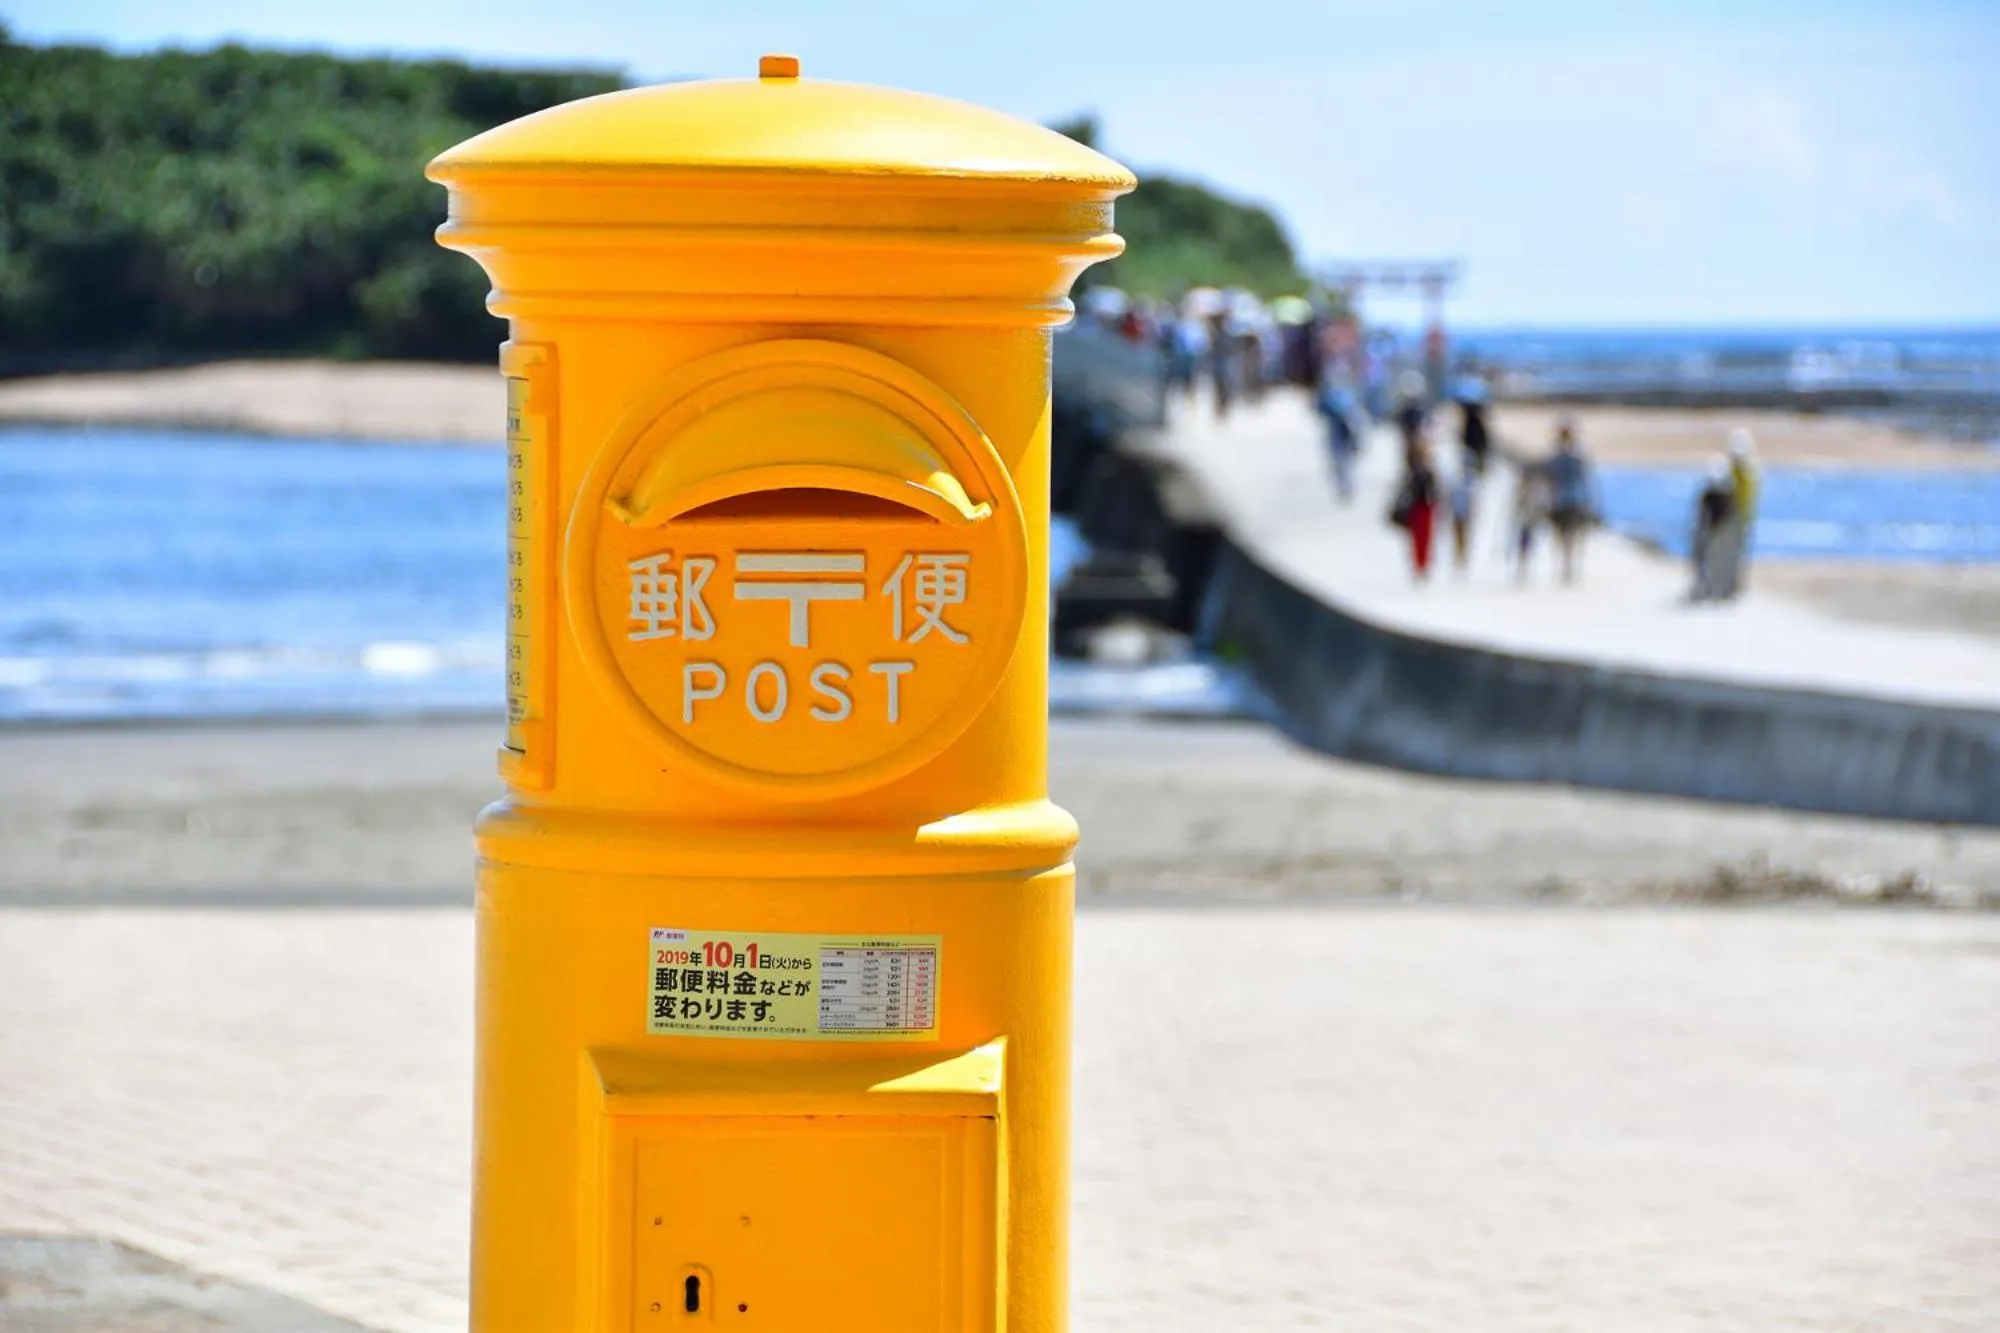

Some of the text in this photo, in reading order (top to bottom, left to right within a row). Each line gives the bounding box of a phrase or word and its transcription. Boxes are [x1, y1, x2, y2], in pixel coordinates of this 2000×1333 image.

[683, 662, 914, 723] POST
[656, 941, 812, 970] 2019年10月1日(火)から
[655, 967, 810, 996] 郵便料金などが
[654, 995, 776, 1022] 変わります。
